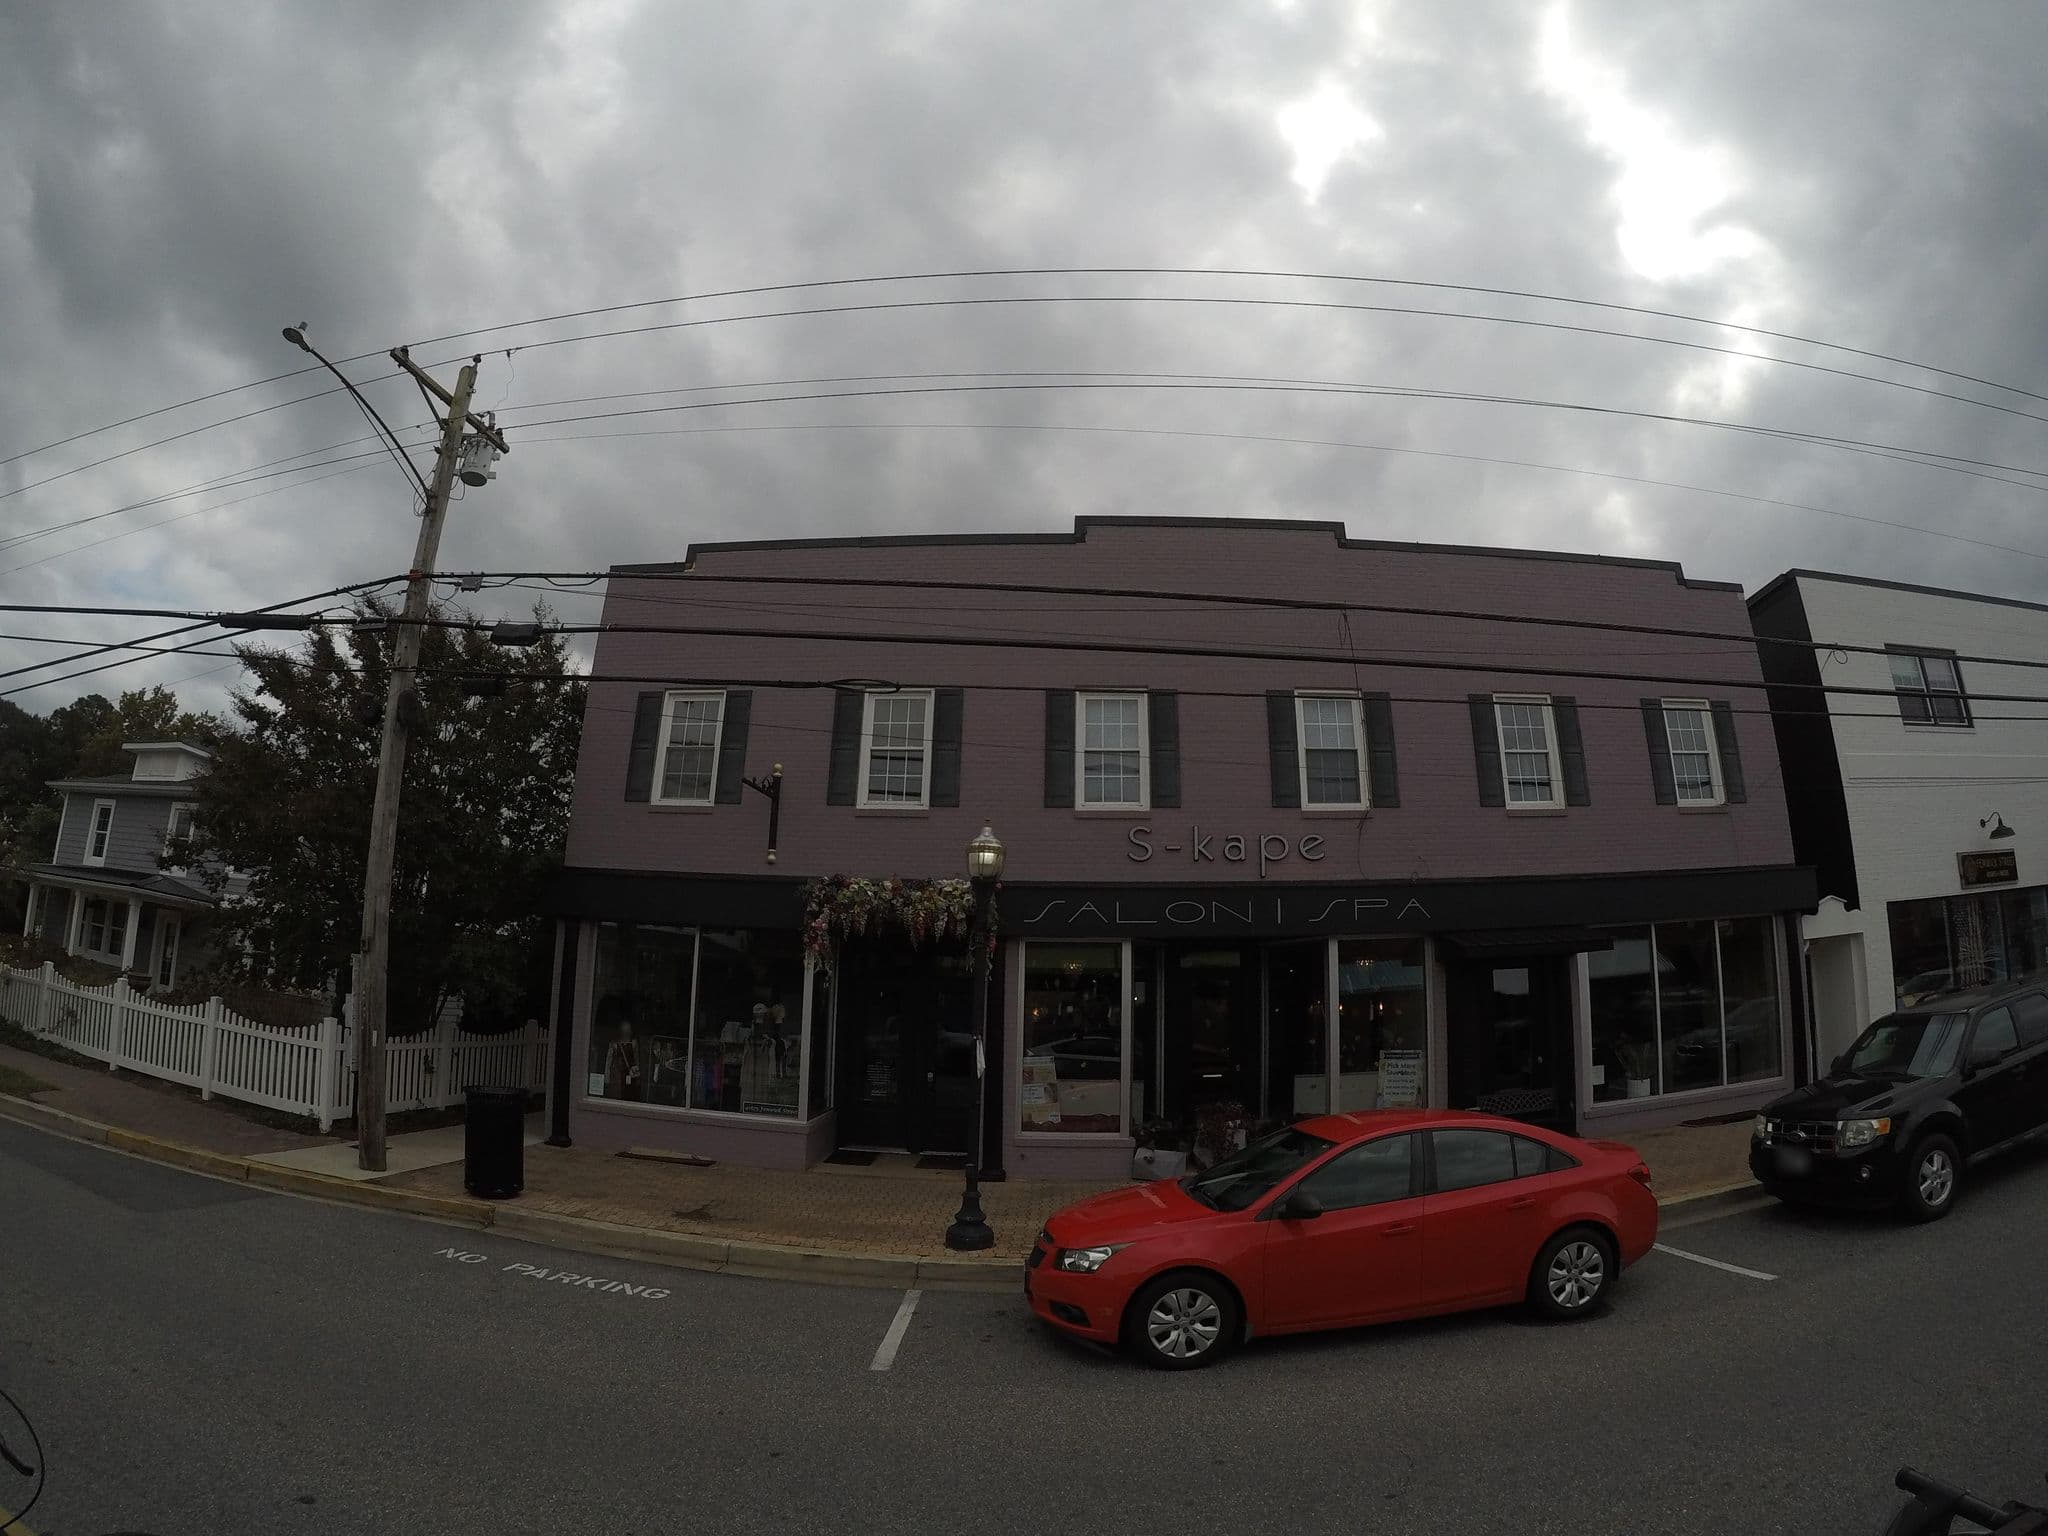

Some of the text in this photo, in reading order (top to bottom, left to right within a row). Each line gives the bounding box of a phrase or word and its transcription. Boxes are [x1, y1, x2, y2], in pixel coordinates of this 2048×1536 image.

[1126, 824, 1327, 878] S-kape
[1022, 899, 1253, 924] SALON
[1307, 898, 1432, 923] SPA
[433, 1247, 672, 1299] NO PARKING
